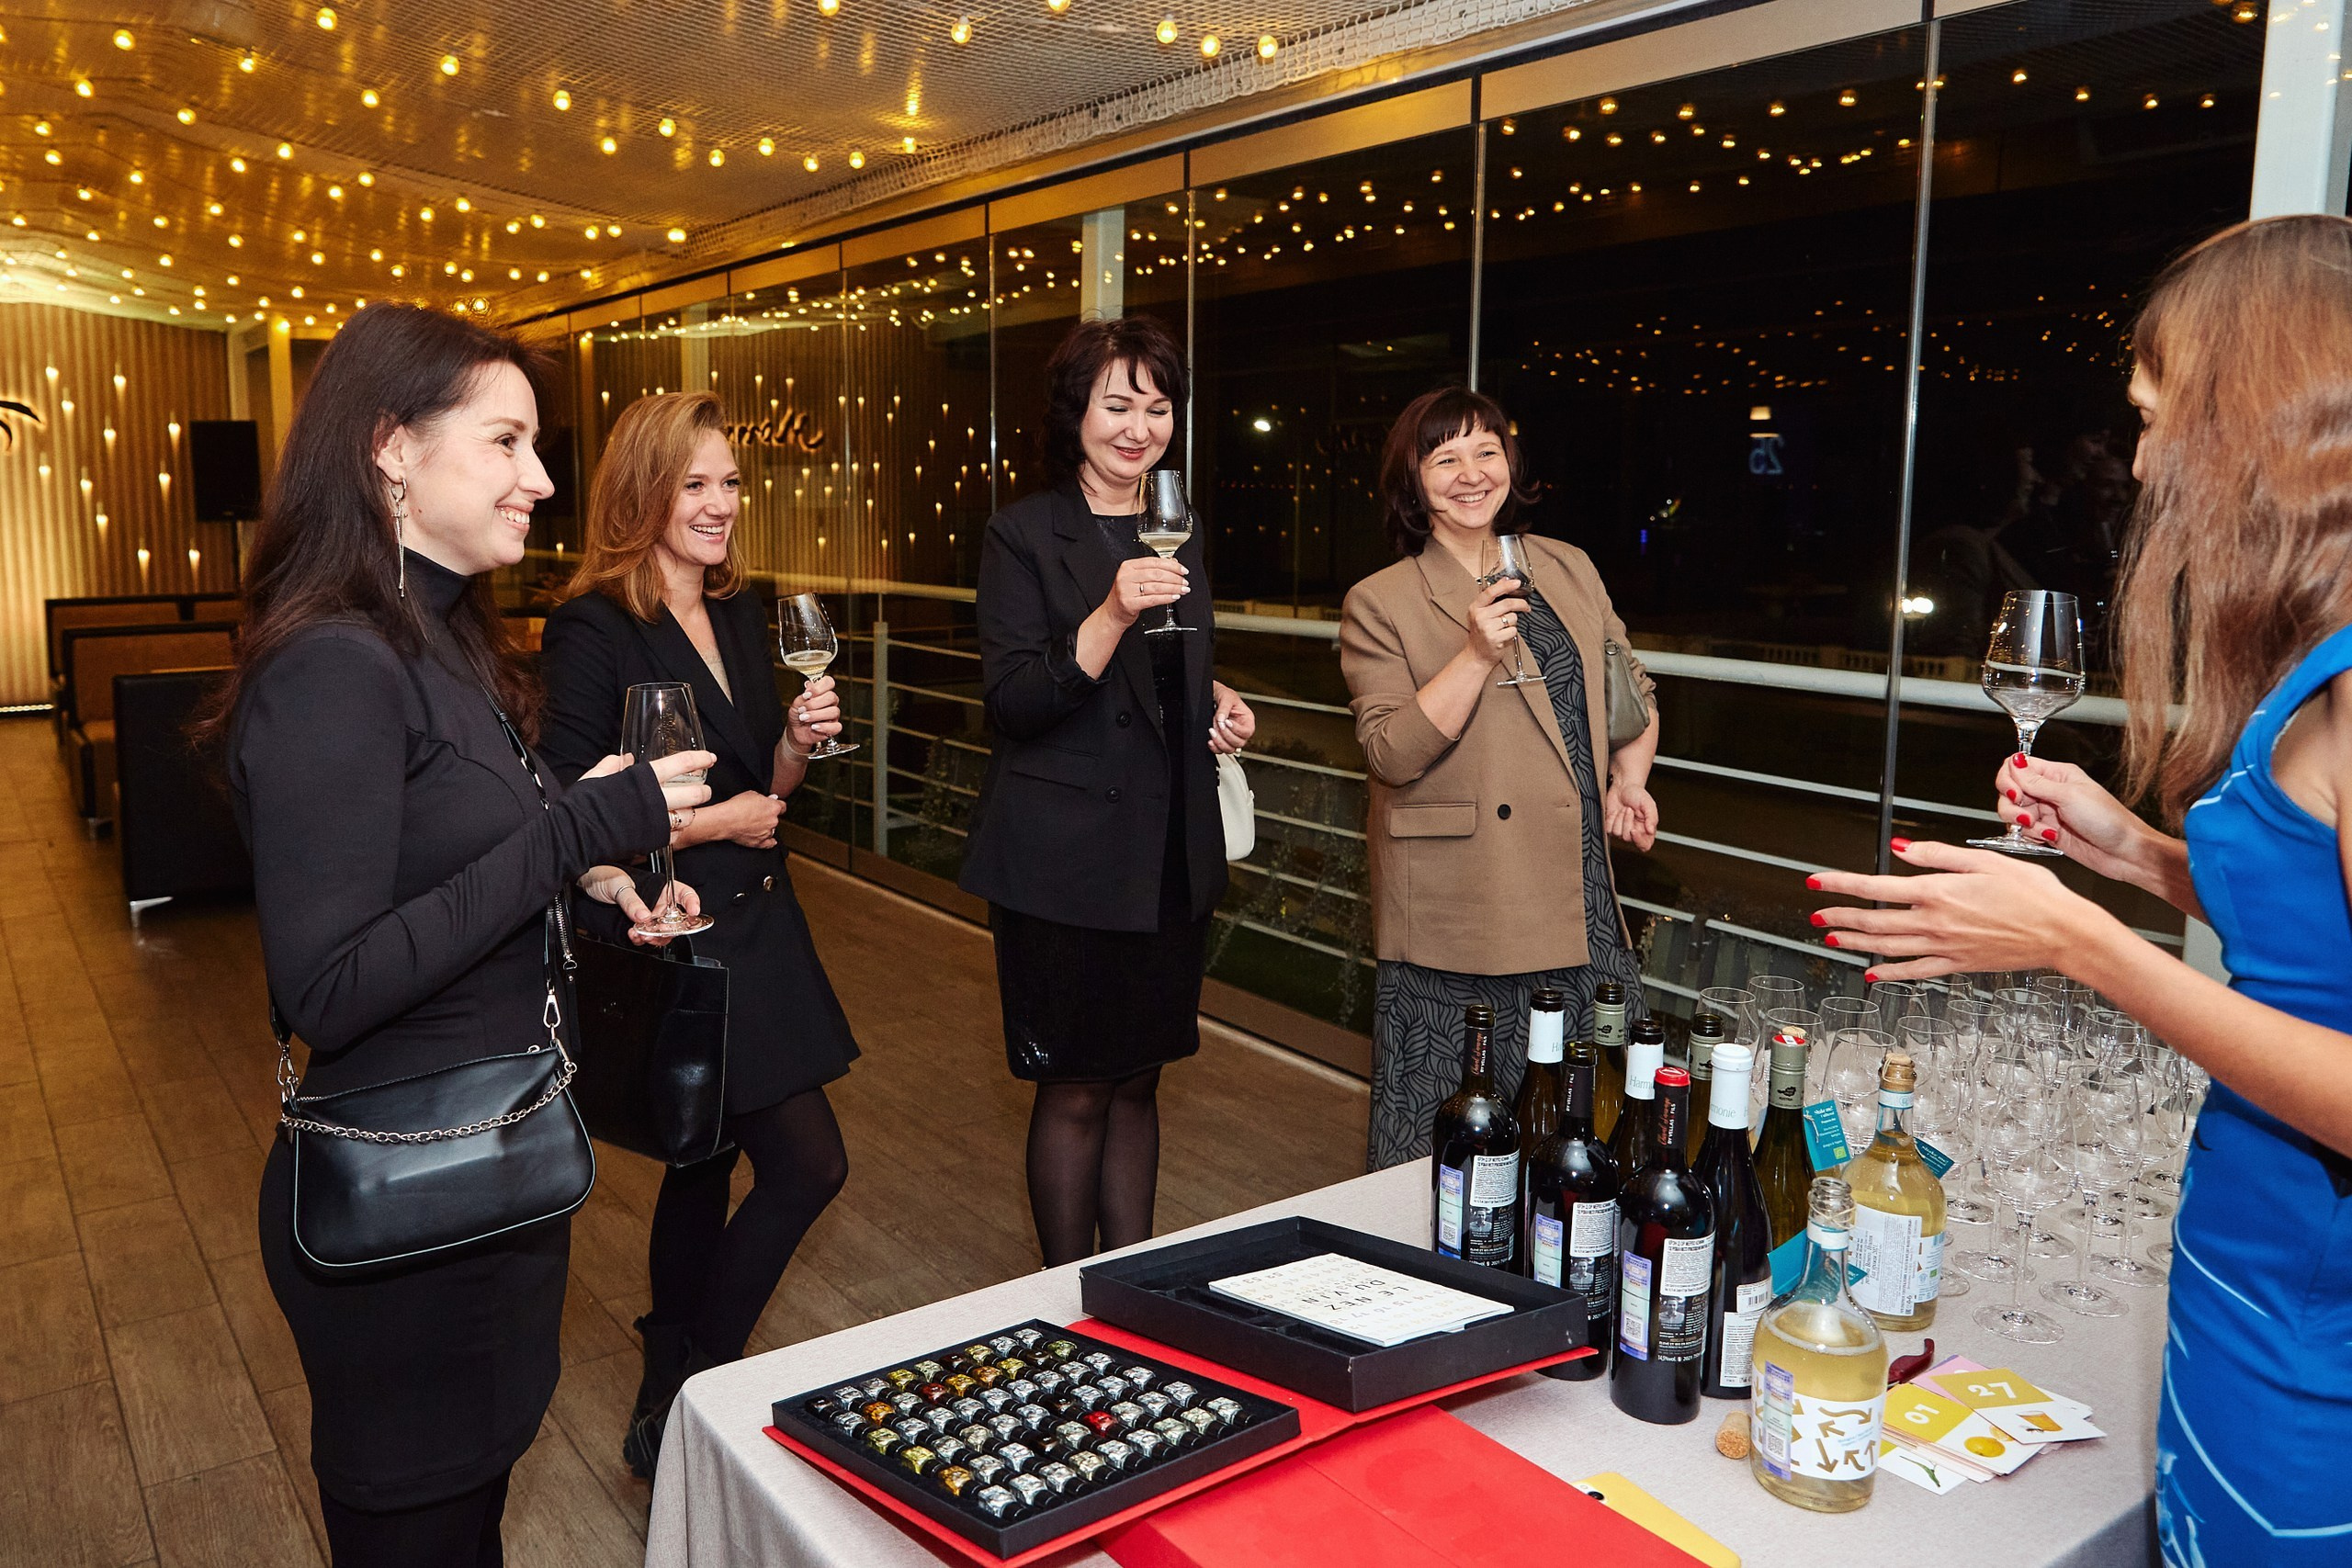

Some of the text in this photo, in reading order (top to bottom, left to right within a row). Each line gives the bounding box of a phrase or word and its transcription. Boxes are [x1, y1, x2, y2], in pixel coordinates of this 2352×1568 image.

[1354, 1280, 1385, 1291] DU
[1302, 1291, 1350, 1303] VIN
[1325, 1287, 1408, 1311] LE NEZ
[1967, 1382, 2017, 1399] 27
